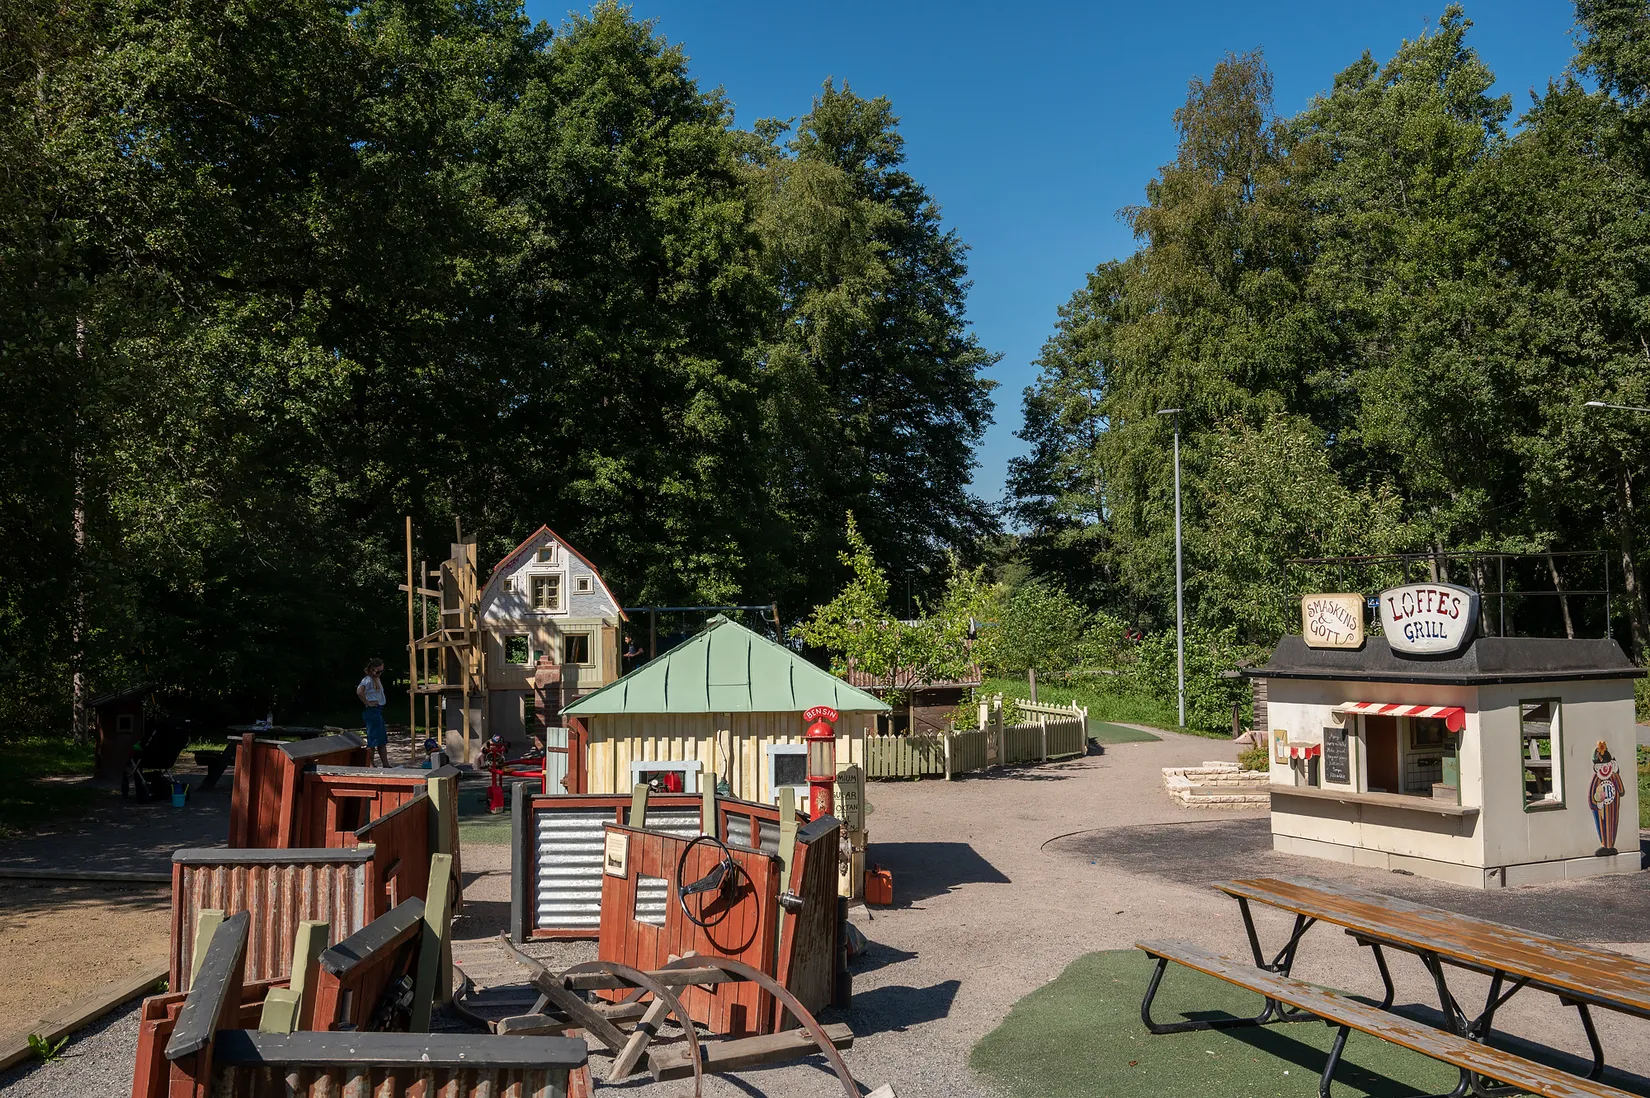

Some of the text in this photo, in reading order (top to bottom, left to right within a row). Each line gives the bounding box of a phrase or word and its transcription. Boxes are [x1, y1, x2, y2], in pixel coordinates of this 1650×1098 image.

[1307, 599, 1357, 630] SMASKENS
[1387, 589, 1461, 621] LOFFES
[1318, 612, 1333, 624] &
[1310, 619, 1341, 645] GOTT
[1404, 620, 1448, 643] GRILL
[806, 708, 837, 719] BENSIN
